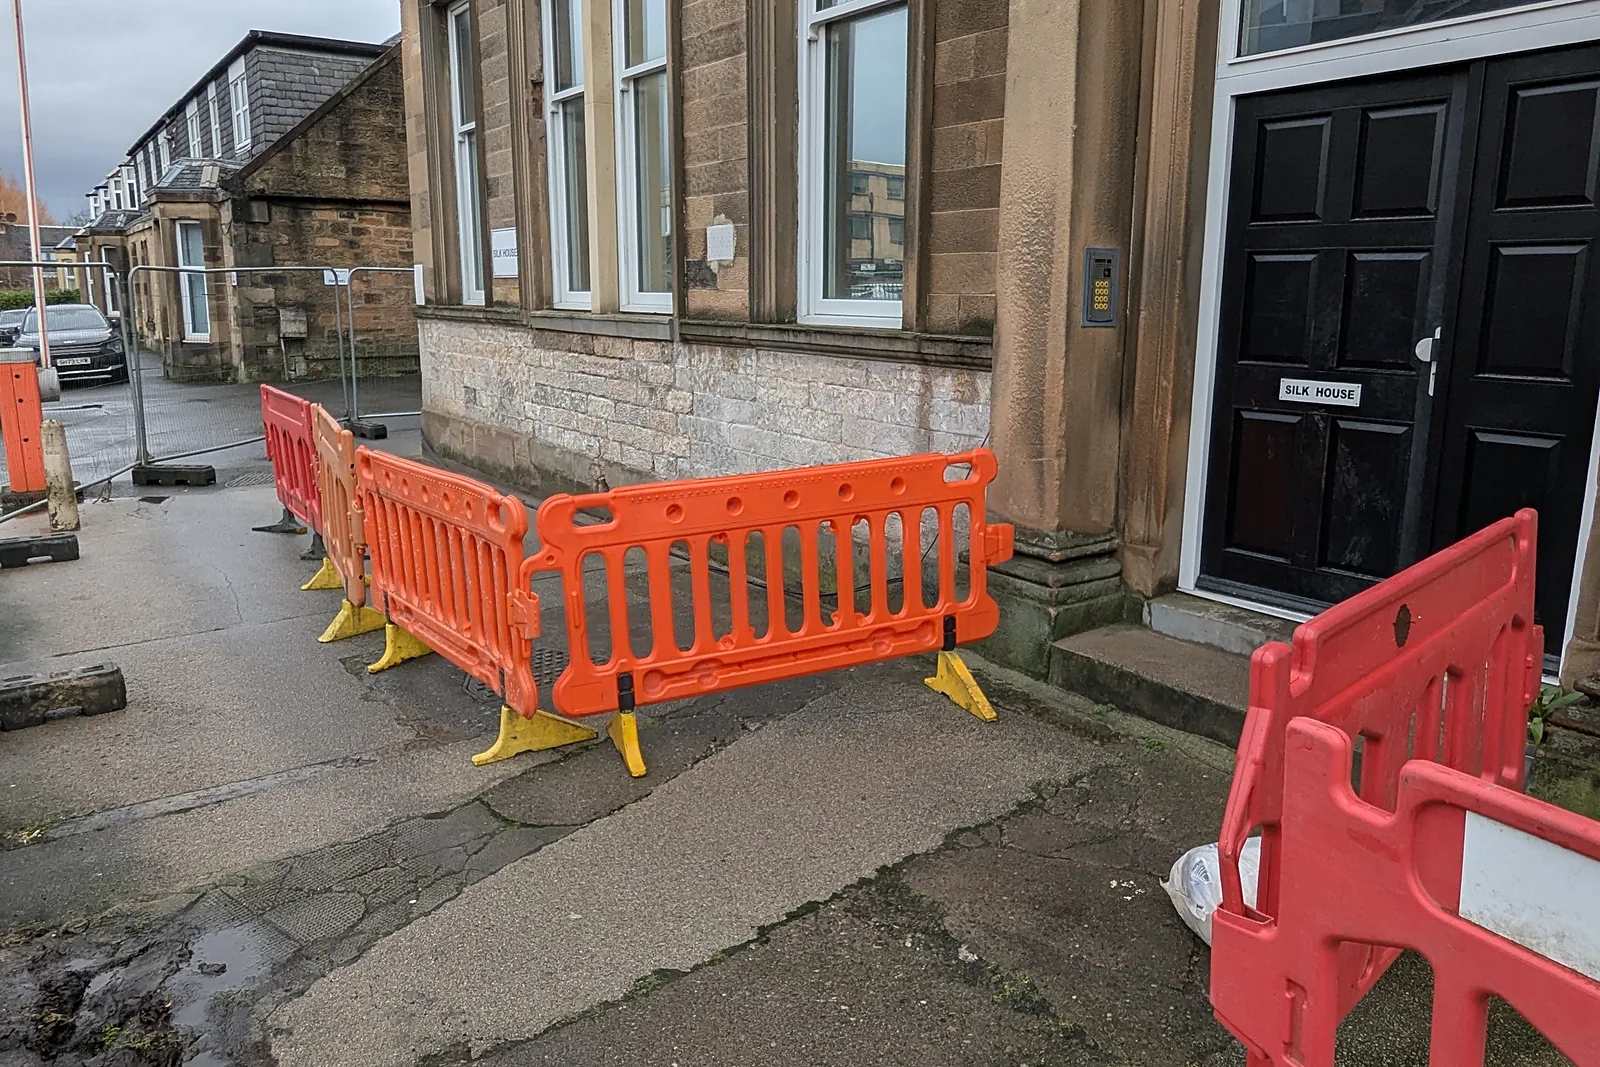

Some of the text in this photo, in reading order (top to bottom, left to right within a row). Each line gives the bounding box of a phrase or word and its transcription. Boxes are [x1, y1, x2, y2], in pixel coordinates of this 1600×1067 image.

[493, 248, 518, 258] SILK HOUSE
[1285, 385, 1355, 400] SILK HOUSE
